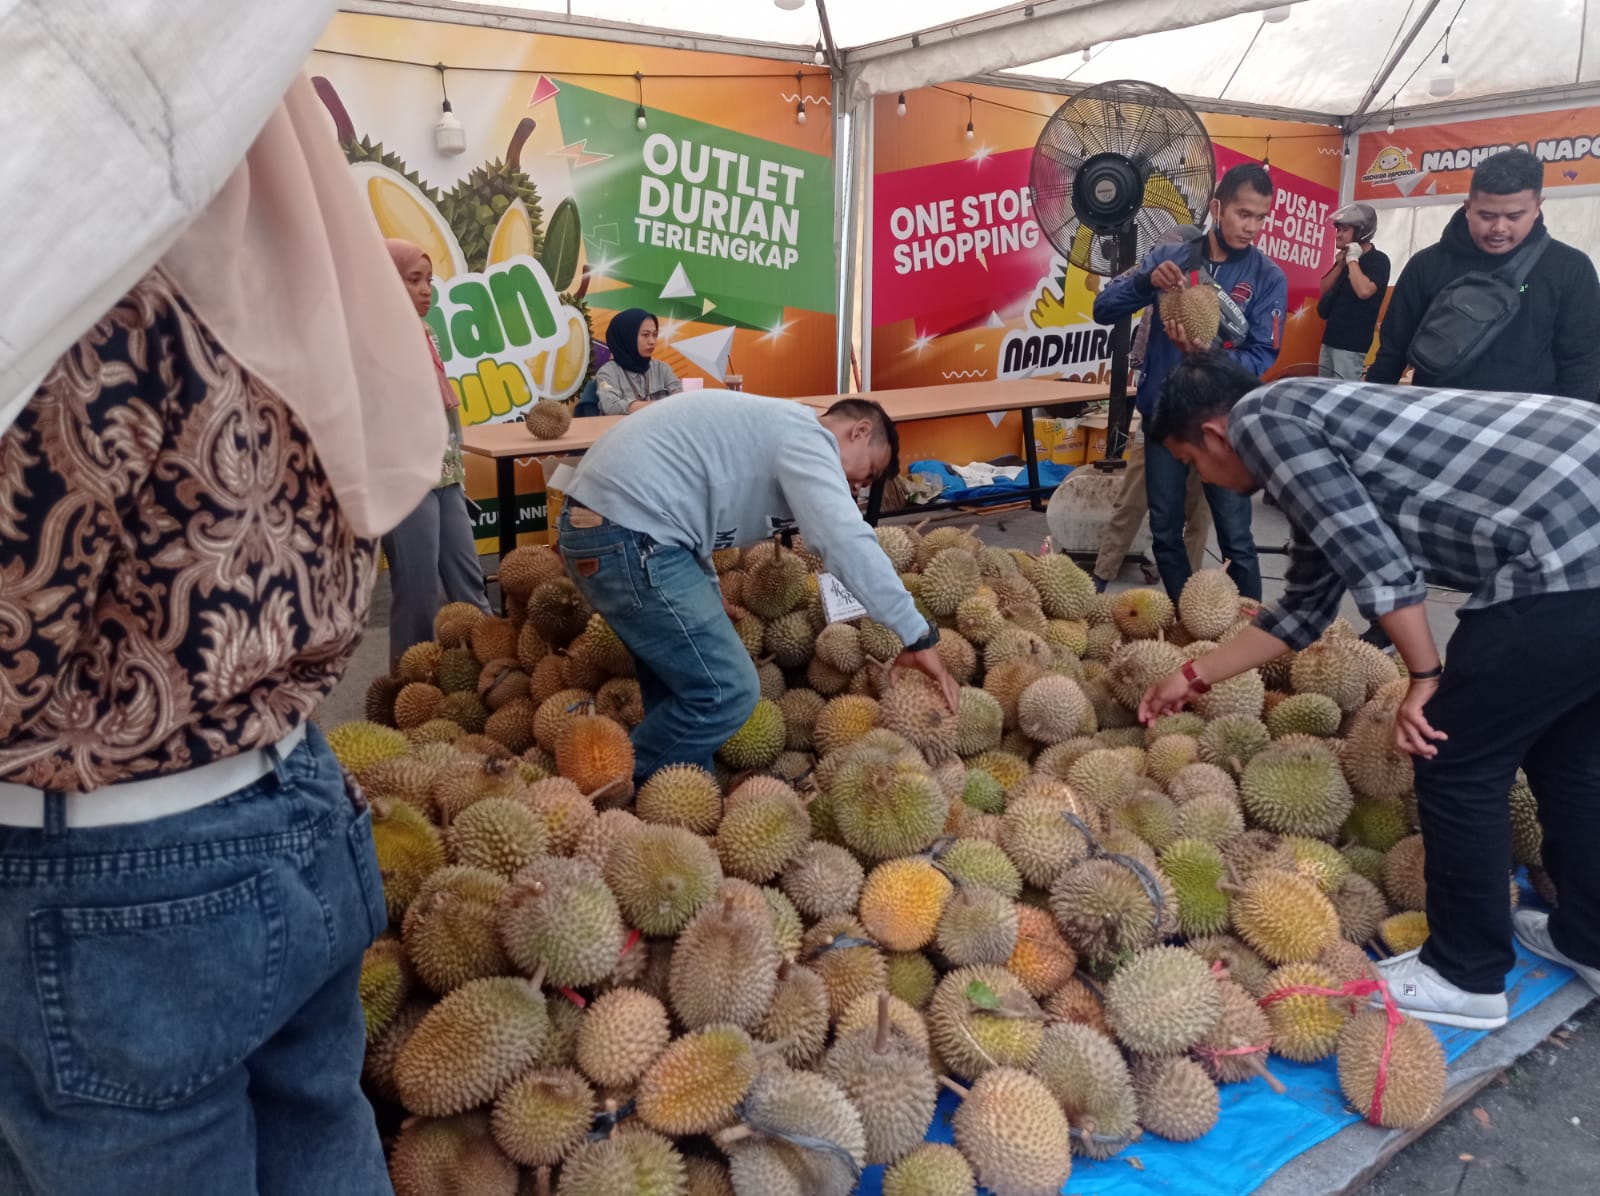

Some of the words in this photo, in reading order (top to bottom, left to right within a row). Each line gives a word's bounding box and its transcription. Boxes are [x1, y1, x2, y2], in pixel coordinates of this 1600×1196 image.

[643, 133, 805, 206] OUTLET
[639, 175, 800, 246] DURIAN
[890, 199, 957, 241] ONE
[961, 186, 1033, 228] STOP
[1274, 187, 1329, 225] PUSAT
[634, 217, 799, 270] TERLENGKAP
[893, 220, 1040, 275] SHOPPING
